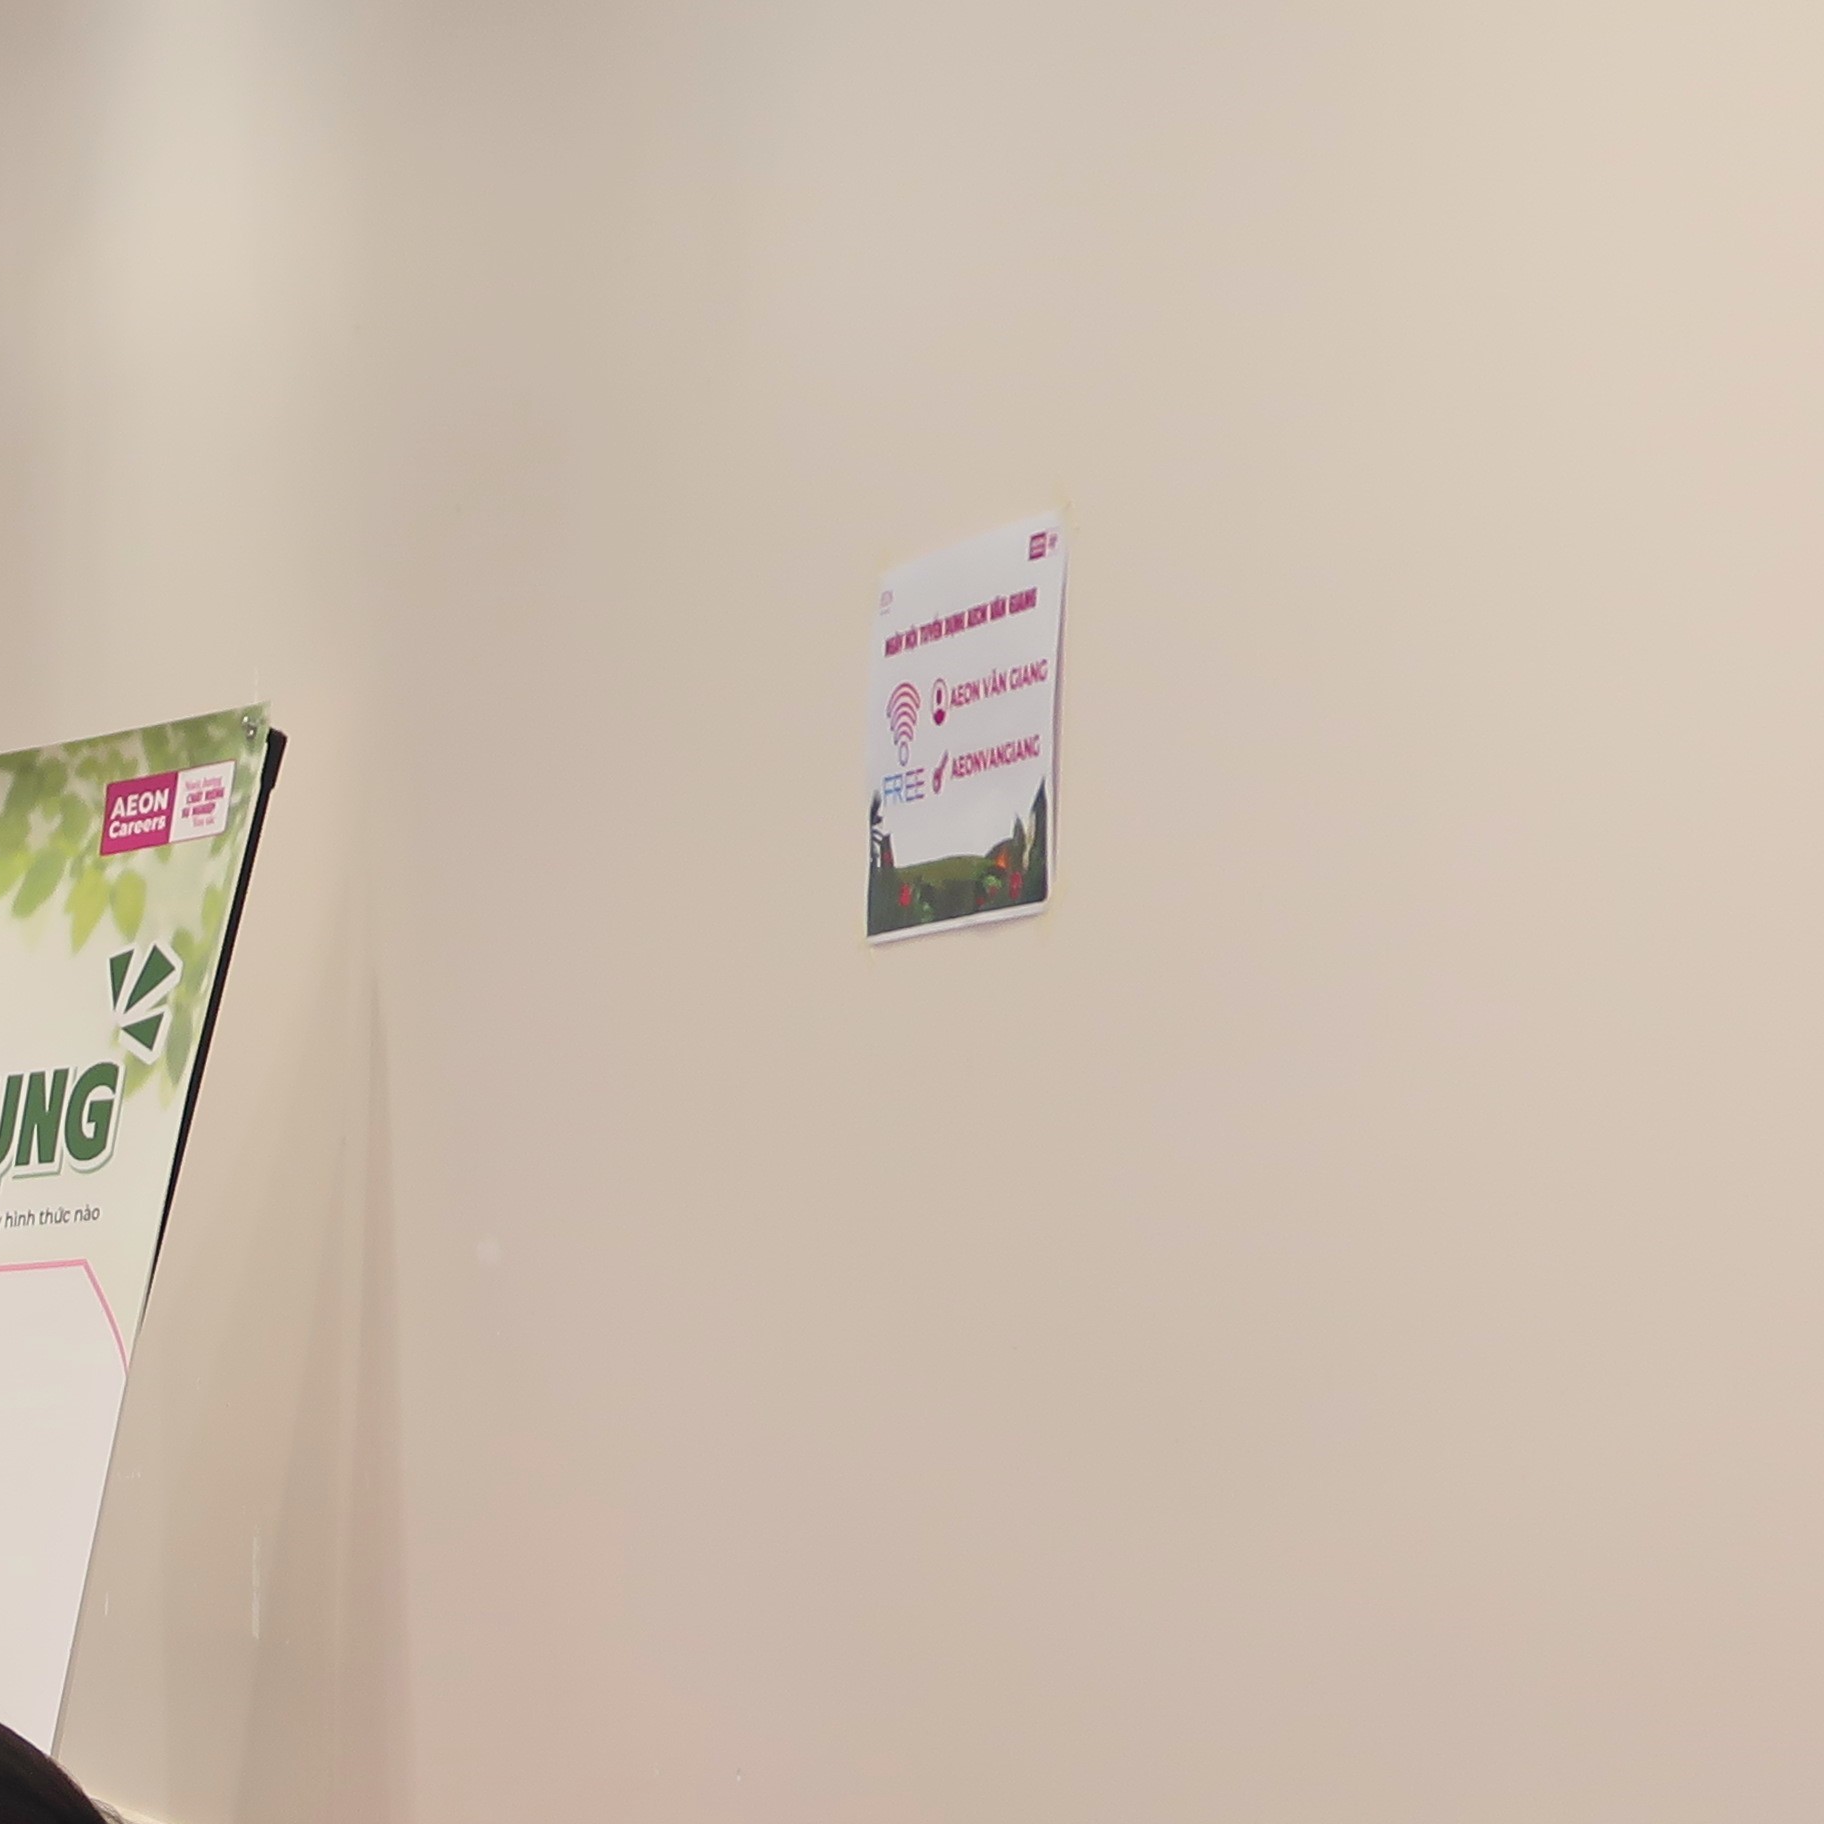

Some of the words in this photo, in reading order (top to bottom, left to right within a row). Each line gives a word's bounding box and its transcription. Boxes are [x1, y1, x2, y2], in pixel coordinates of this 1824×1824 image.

[951, 681, 980, 707] AEON
[983, 668, 1006, 698] VĂN
[1010, 659, 1047, 689] GIANG
[884, 768, 924, 804] FREE
[110, 788, 169, 820] AEON
[109, 815, 166, 839] Careers
[4, 1209, 35, 1228] hình
[39, 1207, 70, 1225] thức
[74, 1204, 100, 1223] nào
